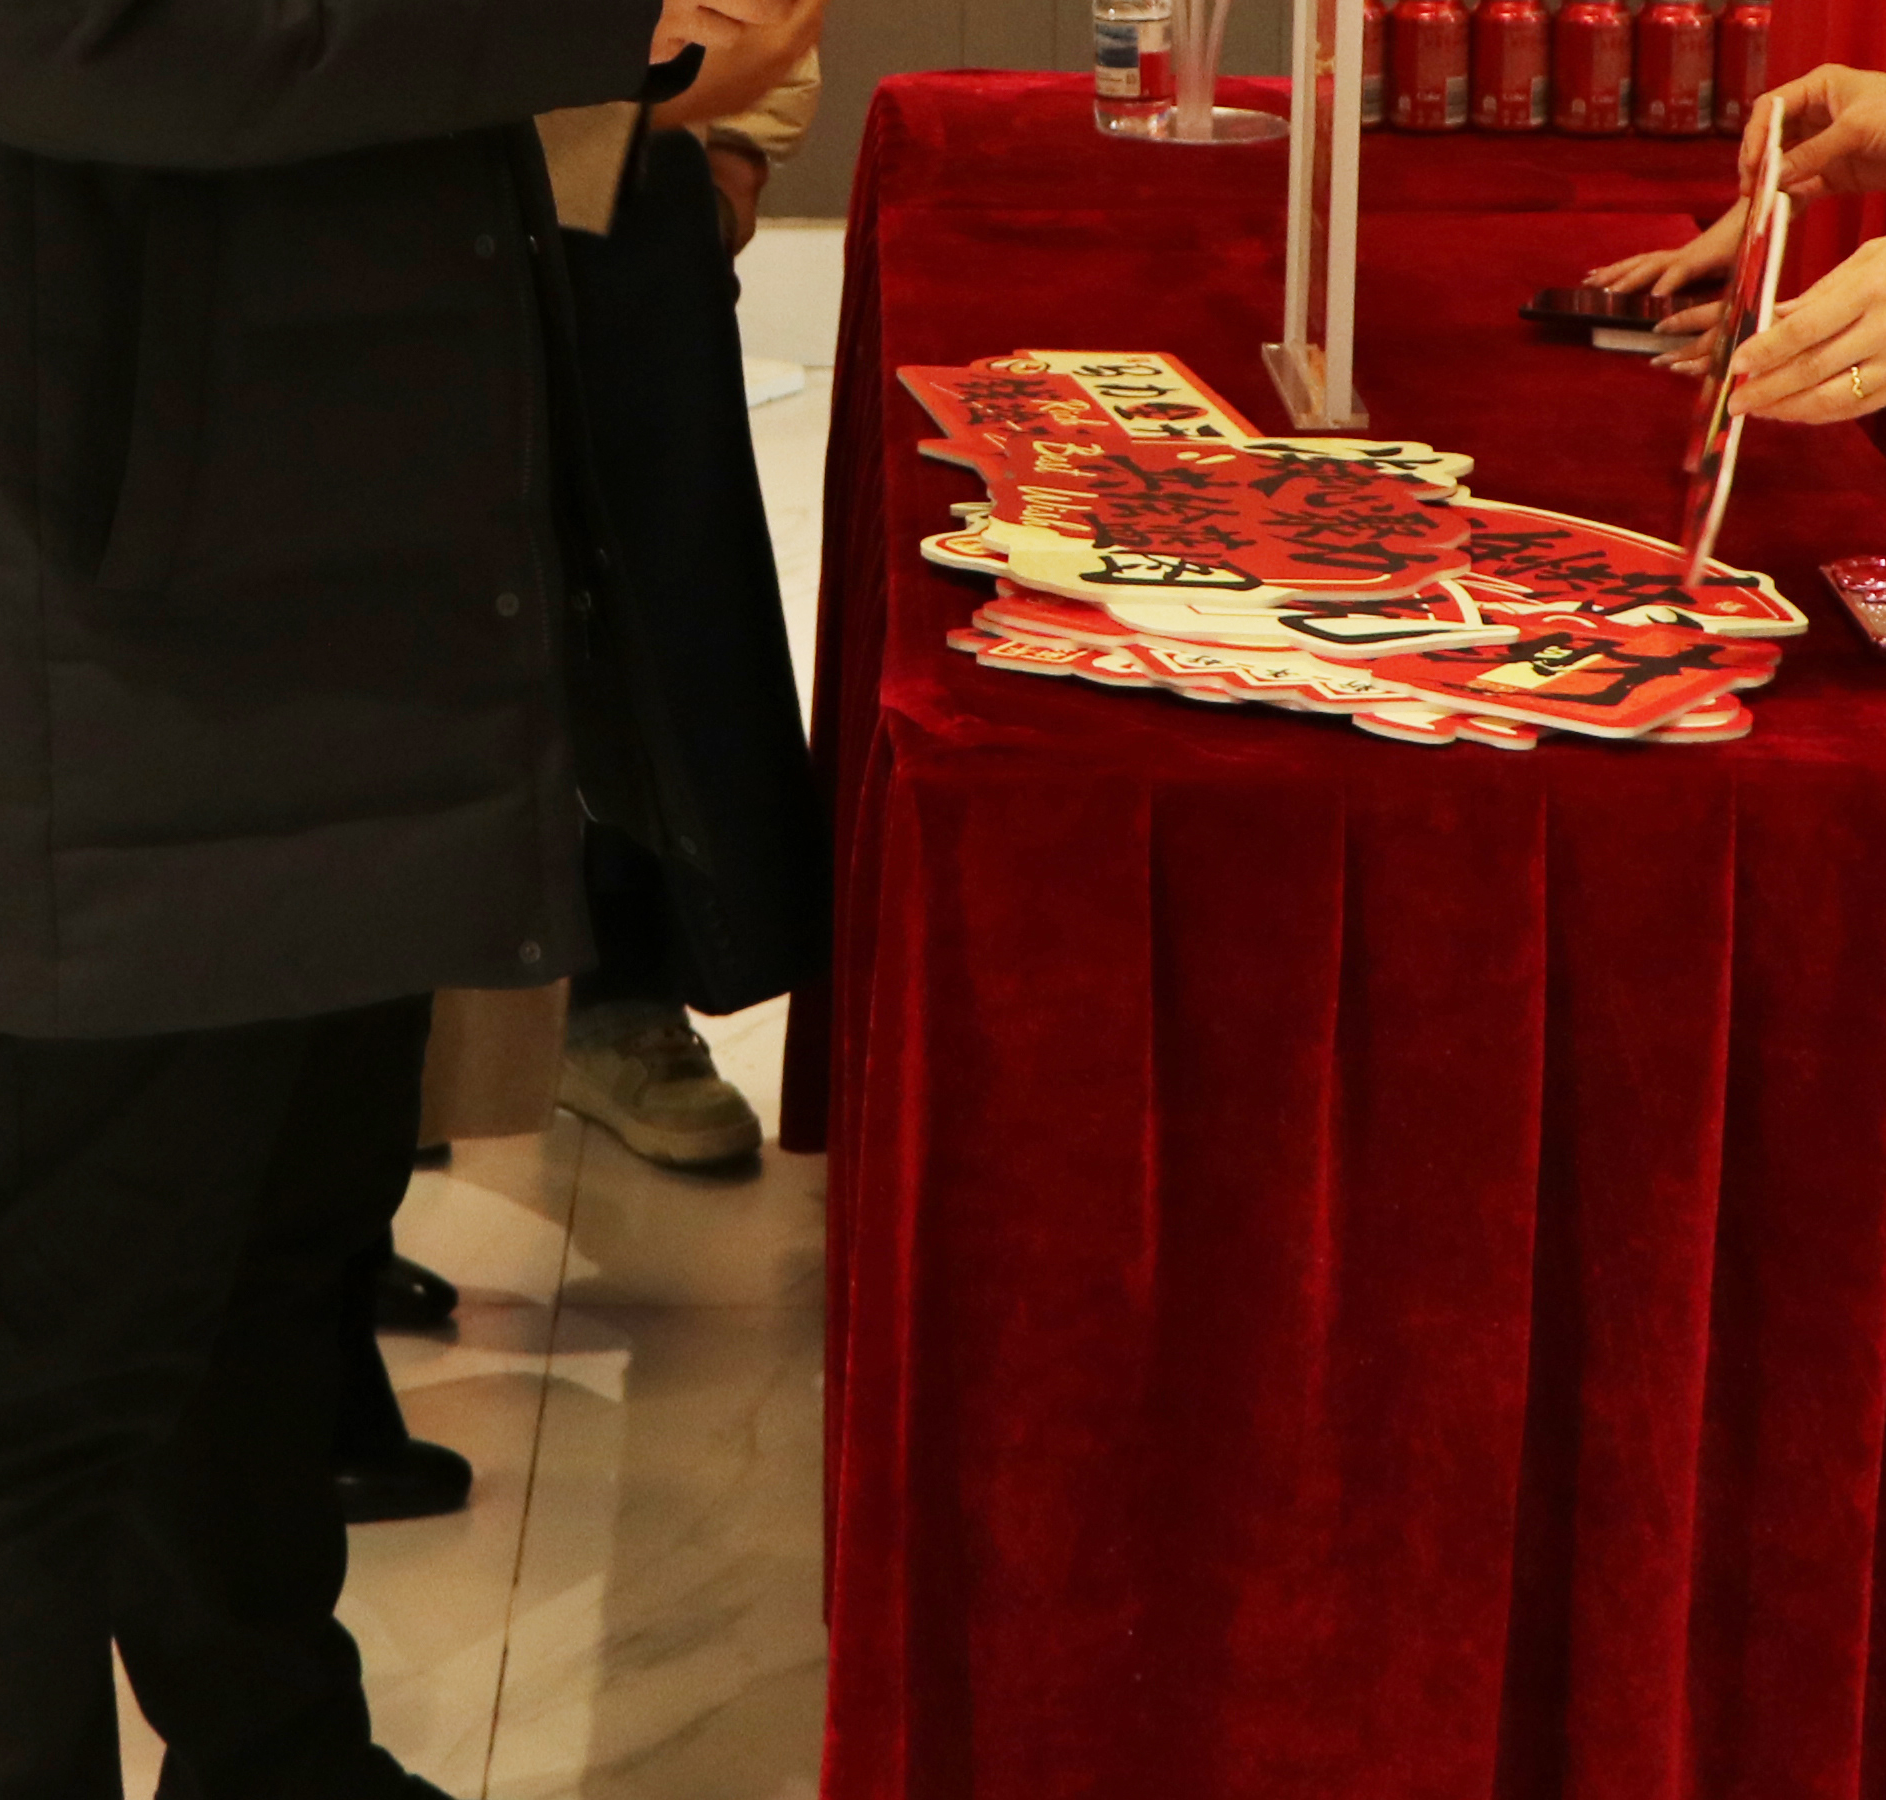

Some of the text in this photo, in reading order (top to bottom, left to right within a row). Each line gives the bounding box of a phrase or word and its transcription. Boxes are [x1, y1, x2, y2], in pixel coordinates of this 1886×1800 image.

[1017, 439, 1105, 532] Best Wish
[1079, 454, 1265, 592] 共绘蓝图
[1243, 442, 1443, 574] 凝心聚力
